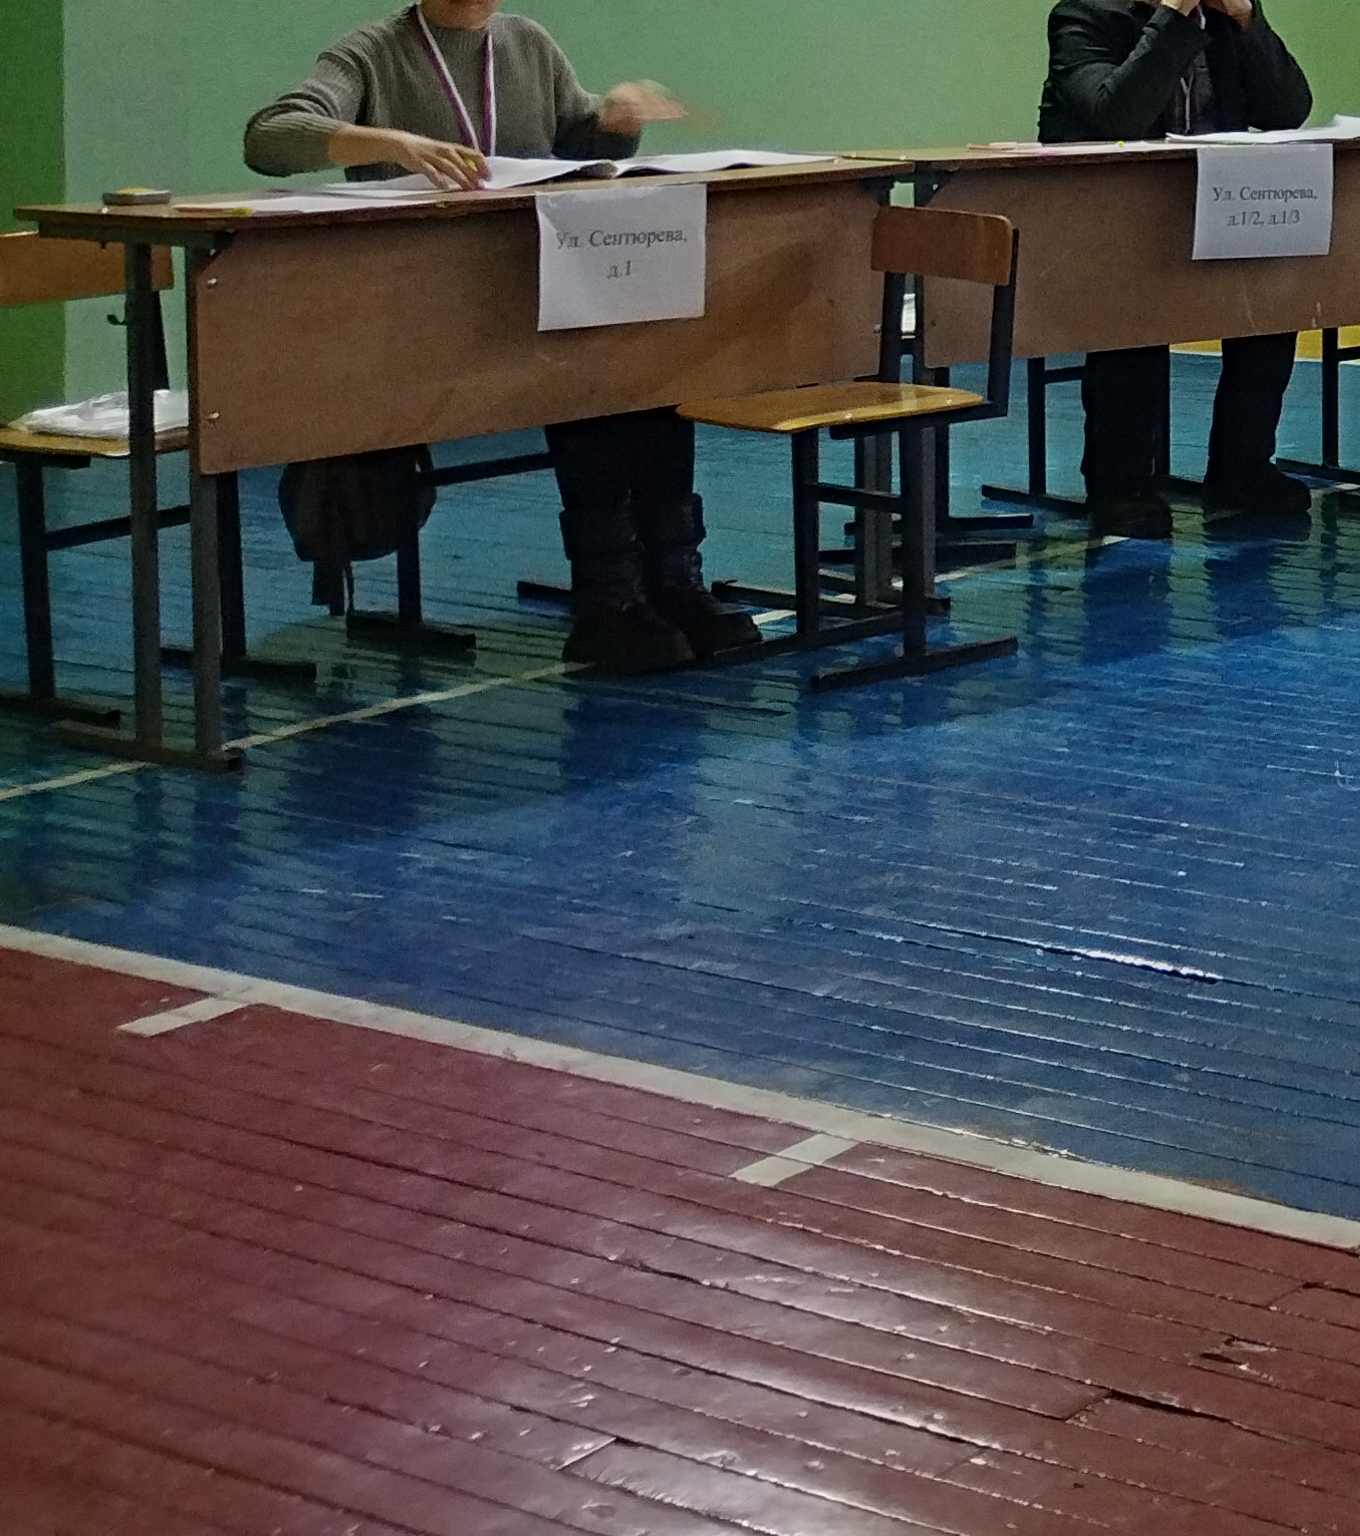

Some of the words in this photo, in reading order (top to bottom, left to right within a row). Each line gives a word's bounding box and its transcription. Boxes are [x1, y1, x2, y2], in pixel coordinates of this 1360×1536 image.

[1212, 187, 1236, 202] Ул.
[1240, 187, 1318, 202] Сентюрева,
[556, 231, 581, 250] Ул.
[589, 229, 688, 249] Сентюрева,
